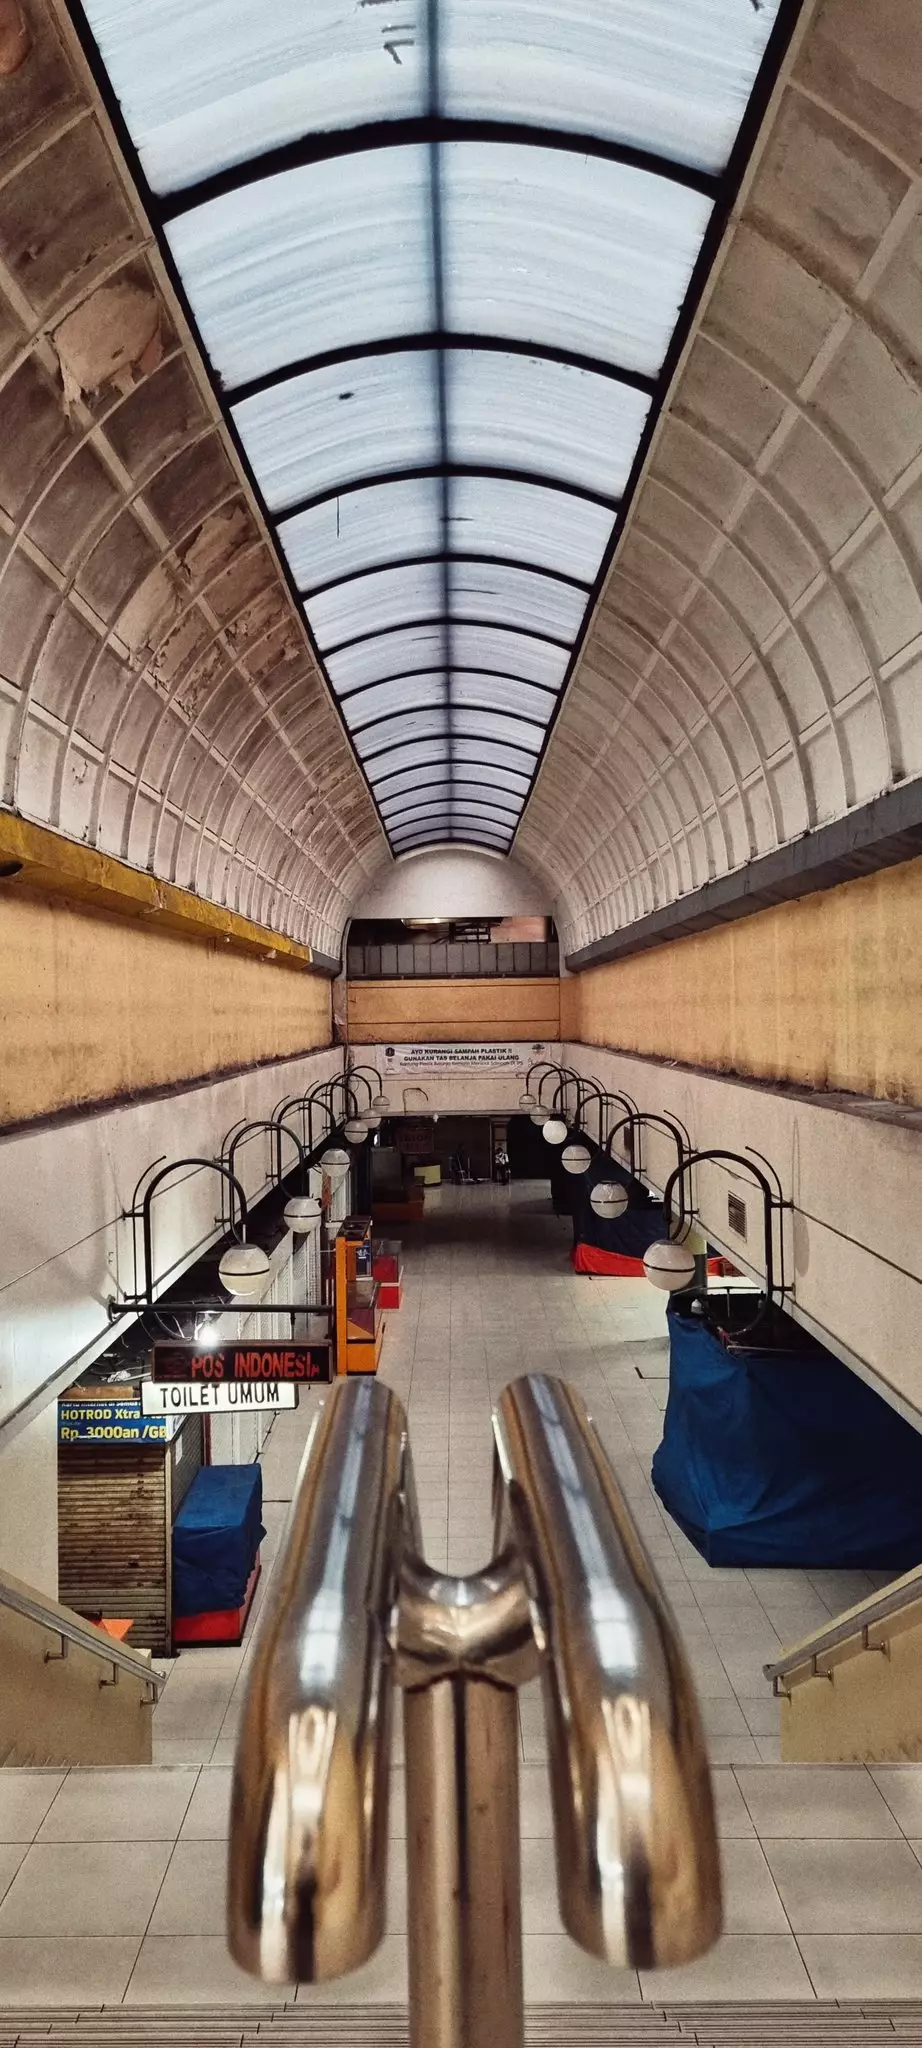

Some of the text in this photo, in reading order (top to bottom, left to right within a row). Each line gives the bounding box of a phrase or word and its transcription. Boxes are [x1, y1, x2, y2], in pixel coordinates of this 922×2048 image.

[191, 1354, 225, 1378] POS
[160, 1383, 280, 1408] TOILET UMUM
[61, 1409, 140, 1420] HOTROD Xtra
[87, 1426, 139, 1439] 3000an
